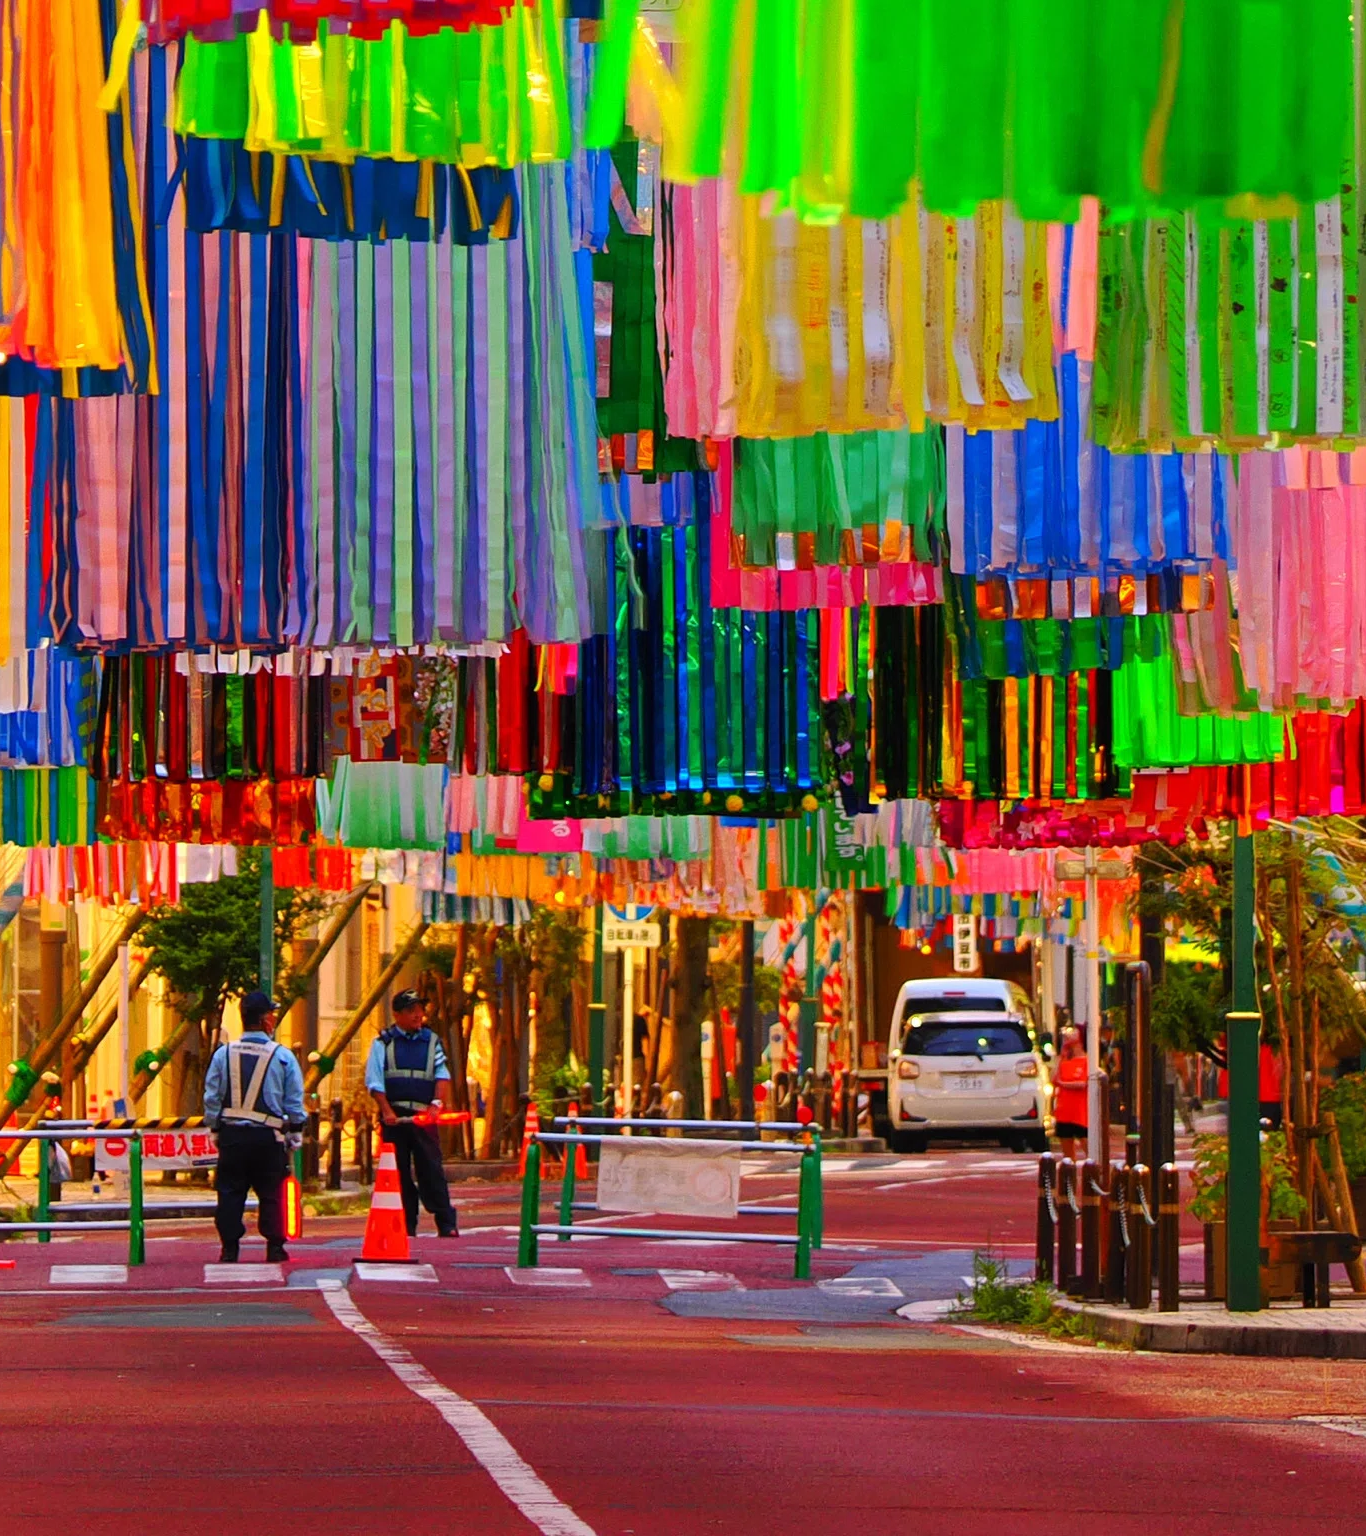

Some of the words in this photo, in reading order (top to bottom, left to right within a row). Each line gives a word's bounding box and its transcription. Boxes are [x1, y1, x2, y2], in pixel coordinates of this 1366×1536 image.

[142, 1133, 219, 1157] 両進入禁止
